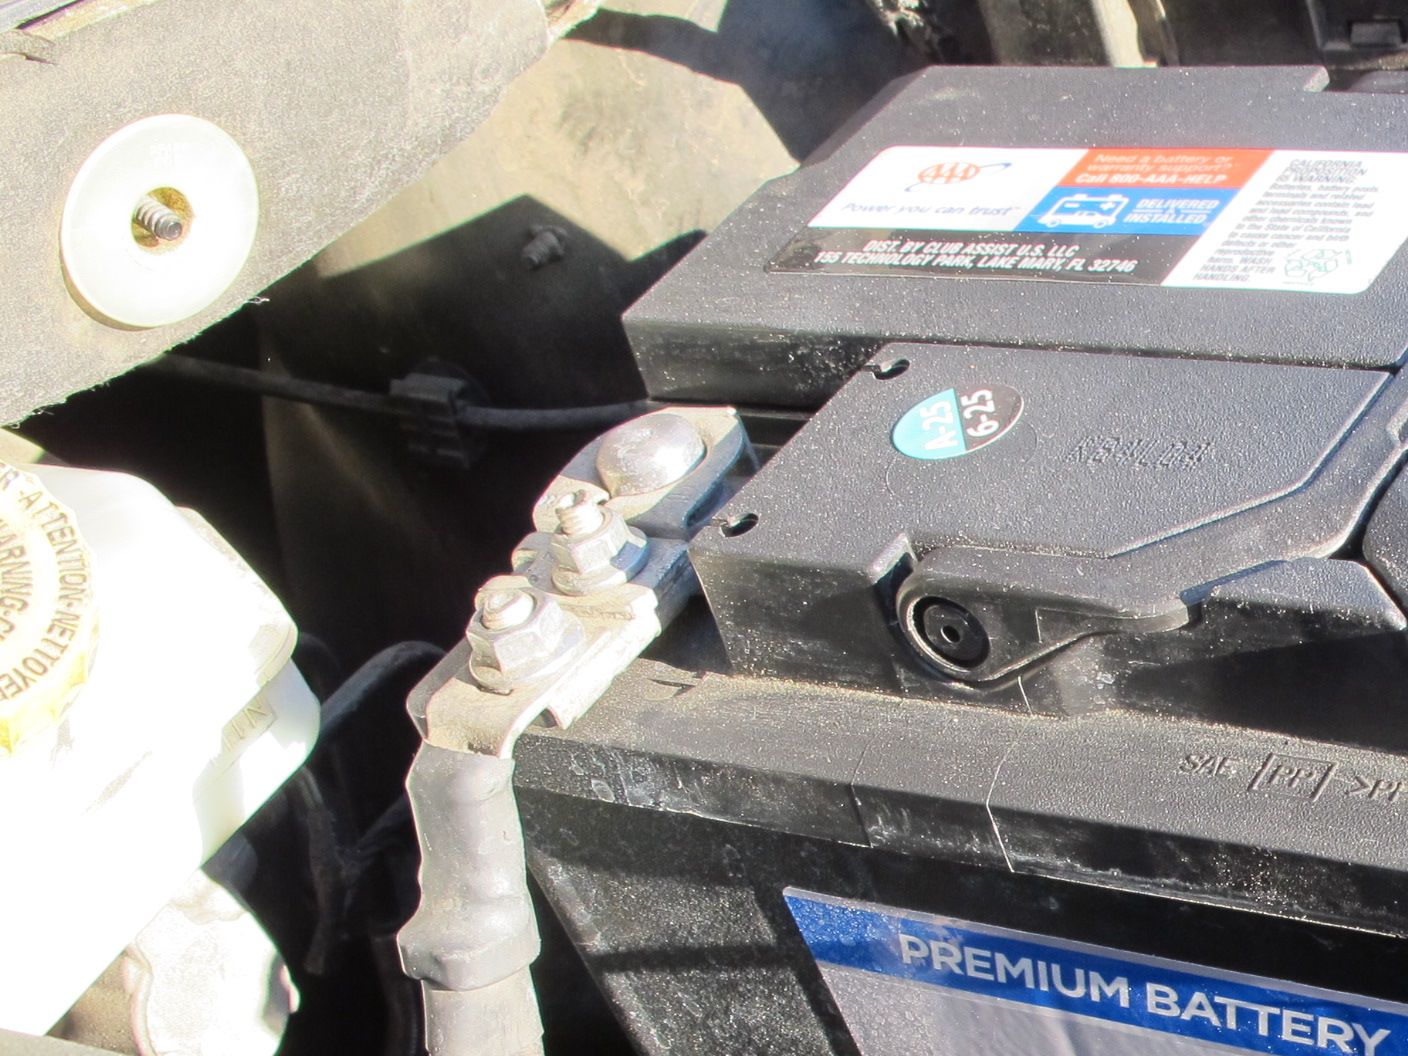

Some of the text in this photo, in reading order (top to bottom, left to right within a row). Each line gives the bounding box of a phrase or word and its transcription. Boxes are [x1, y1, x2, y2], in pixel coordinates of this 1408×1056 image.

[1088, 163, 1151, 173] warranty
[1094, 155, 1138, 163] Need
[1152, 155, 1211, 165] battery
[1075, 173, 1227, 185] Call 800-AAA-HELP
[1135, 198, 1220, 209] DELIVERED
[863, 239, 1080, 259] DIST. BY CLUB ASSIST U.S. LLC
[814, 251, 843, 263] 155
[843, 251, 933, 267] TECHNOLOGY
[932, 254, 977, 269] PARK,
[978, 255, 1020, 269] LAKE
[1066, 258, 1085, 272] FL
[1087, 259, 1139, 273] 32746
[920, 388, 1000, 450] A-25 6-25
[901, 934, 1131, 1009] PREMIUM
